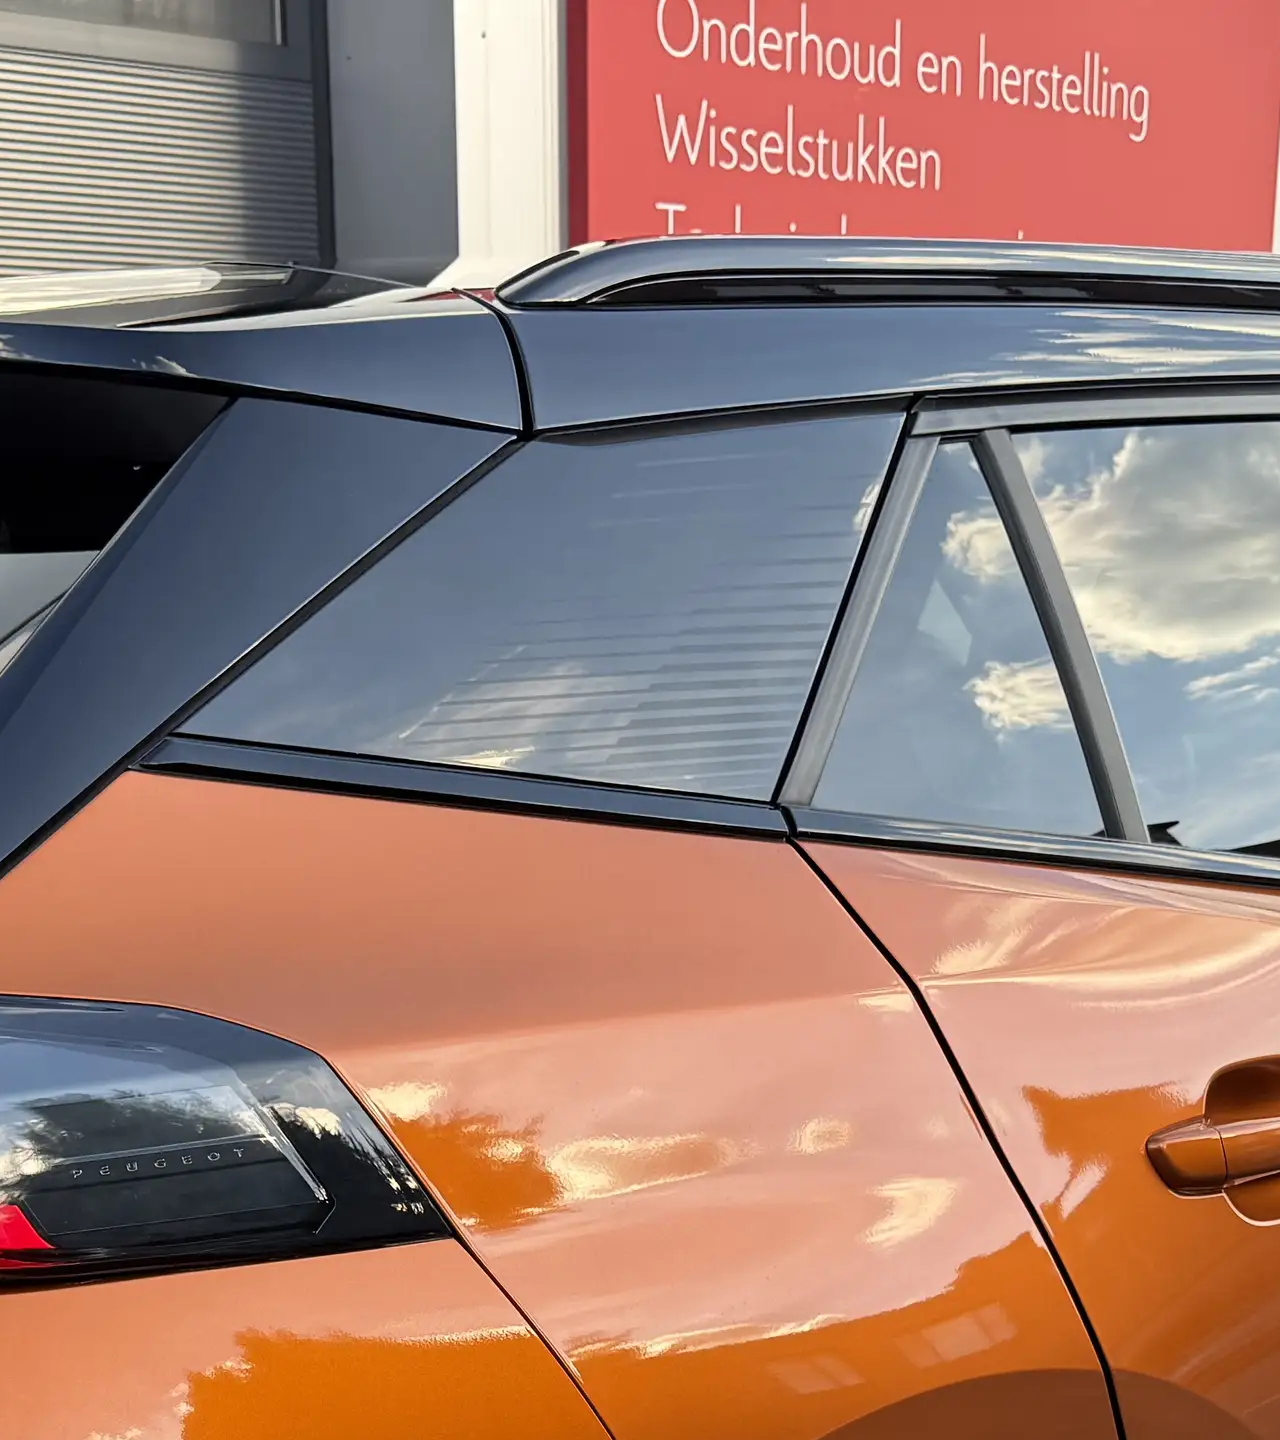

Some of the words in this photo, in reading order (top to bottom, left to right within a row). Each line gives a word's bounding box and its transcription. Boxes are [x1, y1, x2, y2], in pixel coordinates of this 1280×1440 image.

[655, 0, 902, 90] Onderhoud
[917, 50, 962, 98] en
[978, 33, 1150, 142] herstelling
[654, 93, 941, 192] Wisselstukken
[72, 1147, 245, 1179] PEUGEOT
